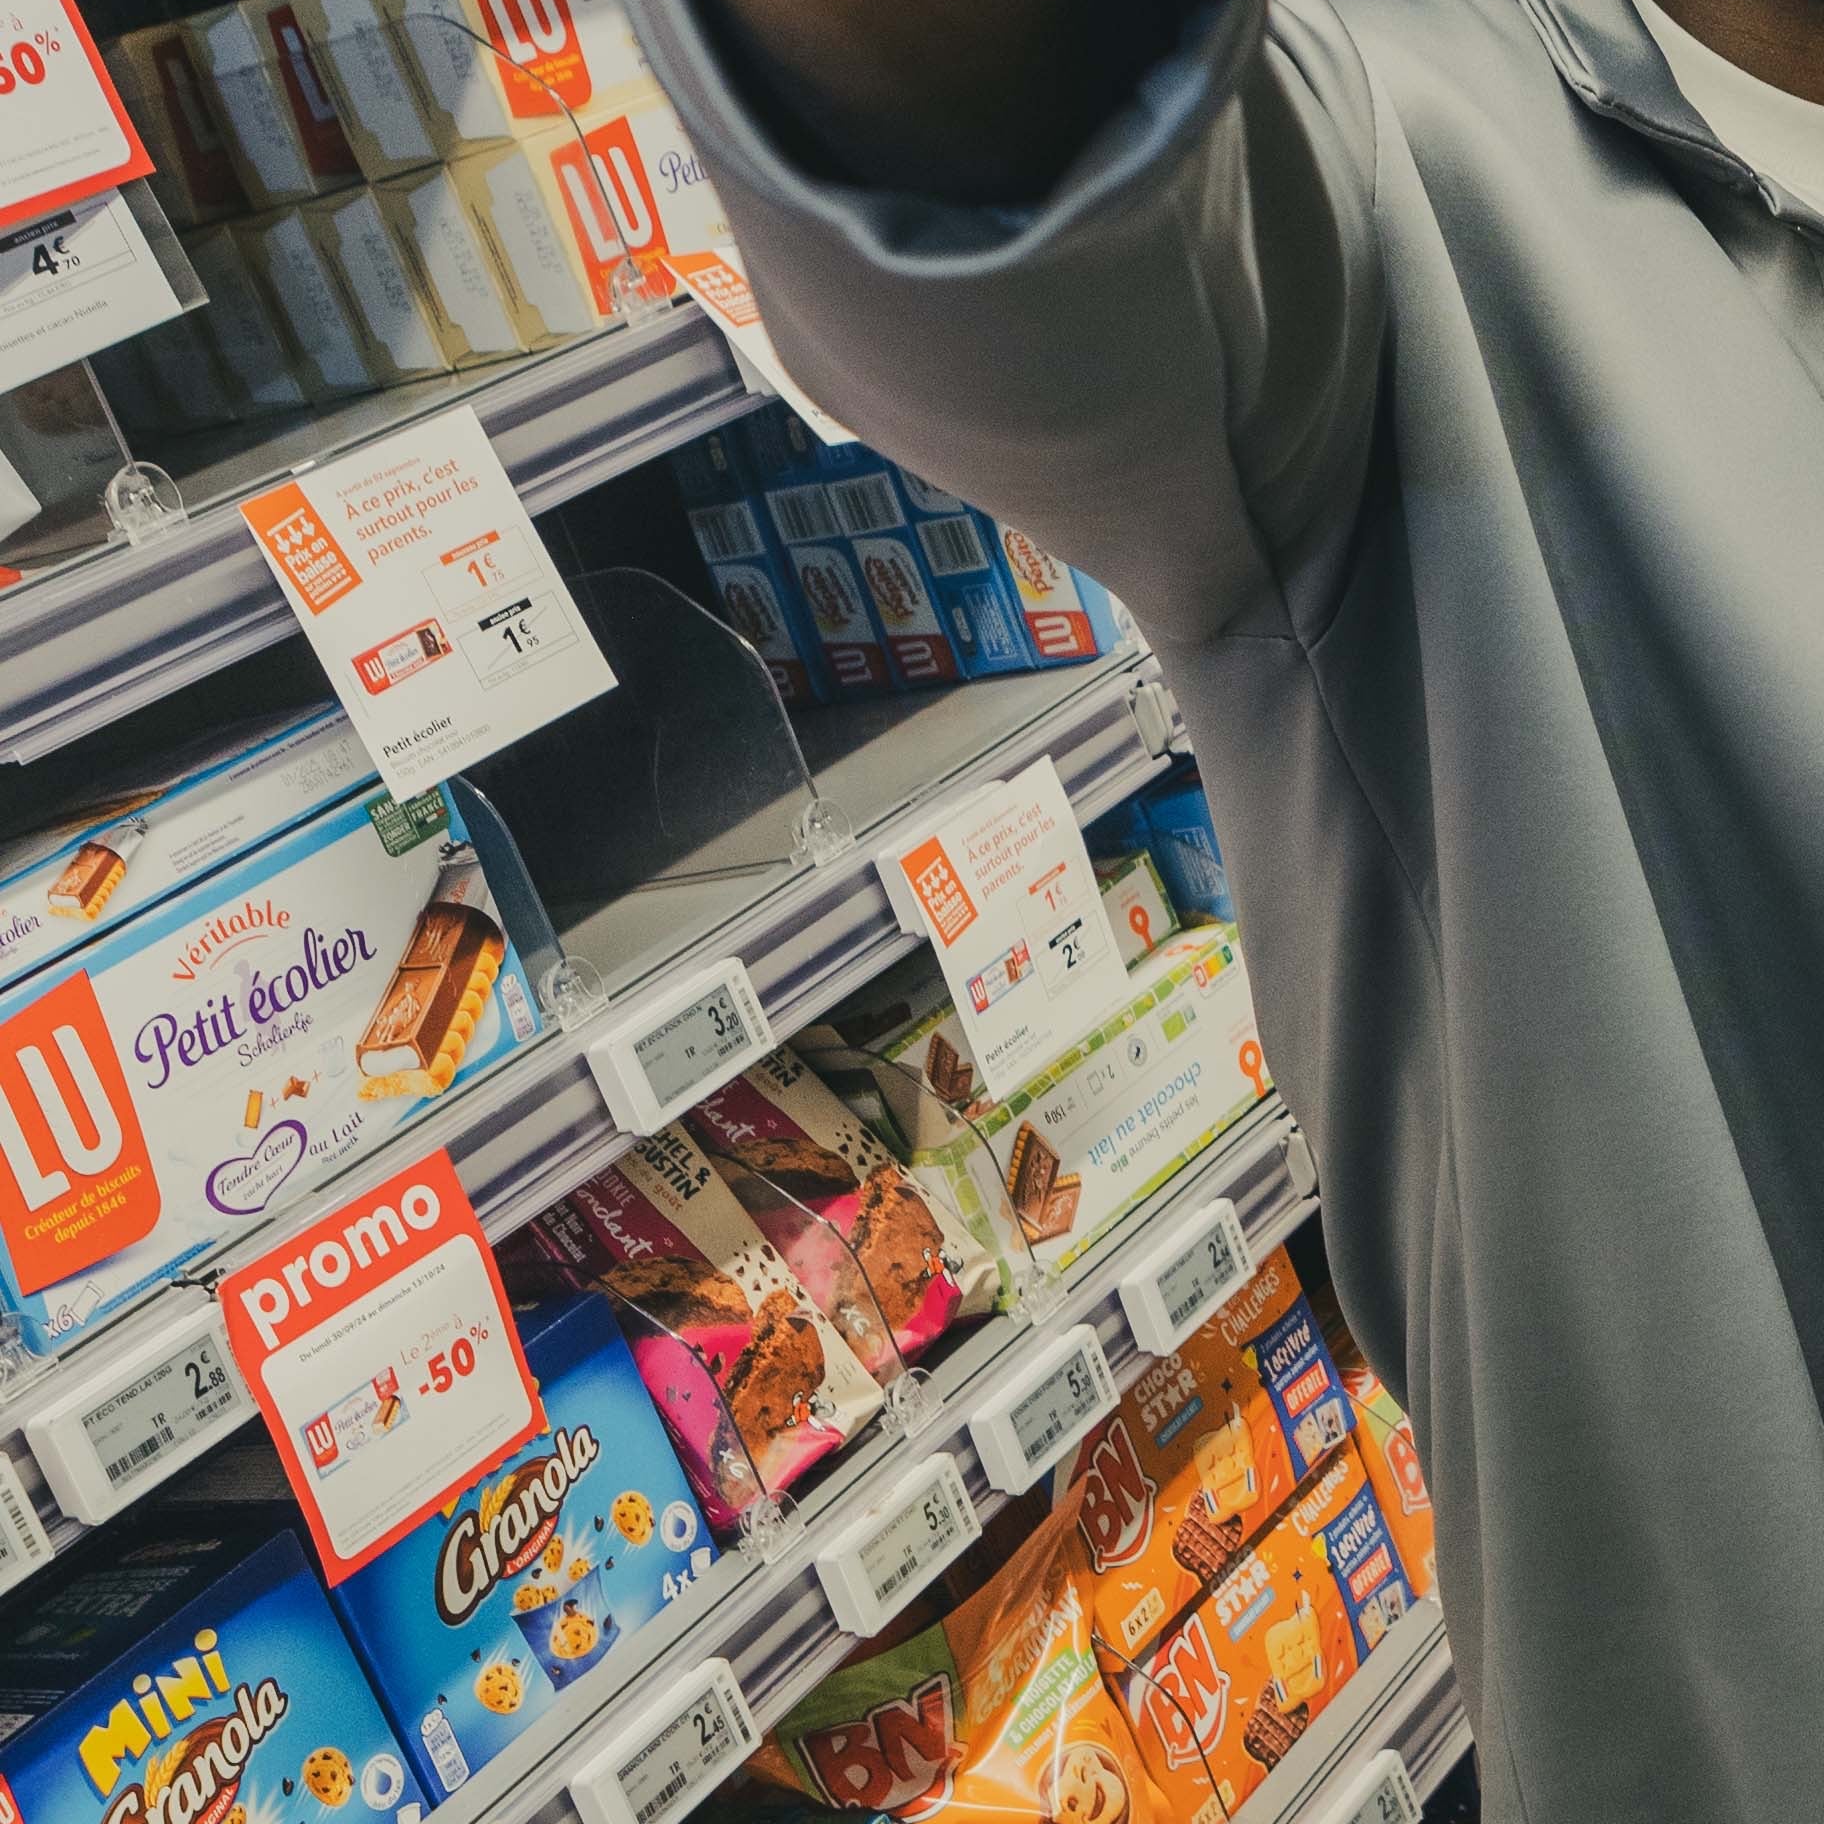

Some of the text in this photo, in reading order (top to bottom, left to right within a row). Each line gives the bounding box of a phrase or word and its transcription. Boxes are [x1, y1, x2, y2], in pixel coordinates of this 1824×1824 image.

[562, 146, 652, 262] LU
[355, 475, 480, 541] surtout pour les
[361, 495, 382, 514] ce
[423, 457, 460, 486] c'est
[366, 527, 433, 566] parents.
[1034, 615, 1079, 656] LU
[382, 734, 413, 759] Petit
[412, 714, 454, 743] écolier
[1014, 831, 1041, 854] pour
[173, 900, 290, 981] Véritable
[134, 927, 378, 1089] Petit écolier
[236, 1011, 314, 1068] Scholiertje
[0, 1024, 123, 1213] LU
[1087, 1061, 1202, 1167] chocolat au lait
[217, 1157, 262, 1196] Tendre
[309, 1141, 330, 1157] au
[24, 1164, 142, 1241] Créateur de biscuits
[54, 1192, 128, 1245] depuis 1846
[240, 1184, 441, 1350] promo
[400, 1345, 421, 1367] Le
[1135, 1354, 1183, 1404] CHOCO
[151, 1412, 167, 1429] TR
[307, 1420, 335, 1457] LU
[1082, 1420, 1146, 1558] BN
[441, 1424, 599, 1615] Granola
[505, 1519, 555, 1574] L'ORIGINAL
[661, 1570, 690, 1602] 4x
[1146, 1616, 1224, 1756] BN
[802, 1676, 952, 1812] BN
